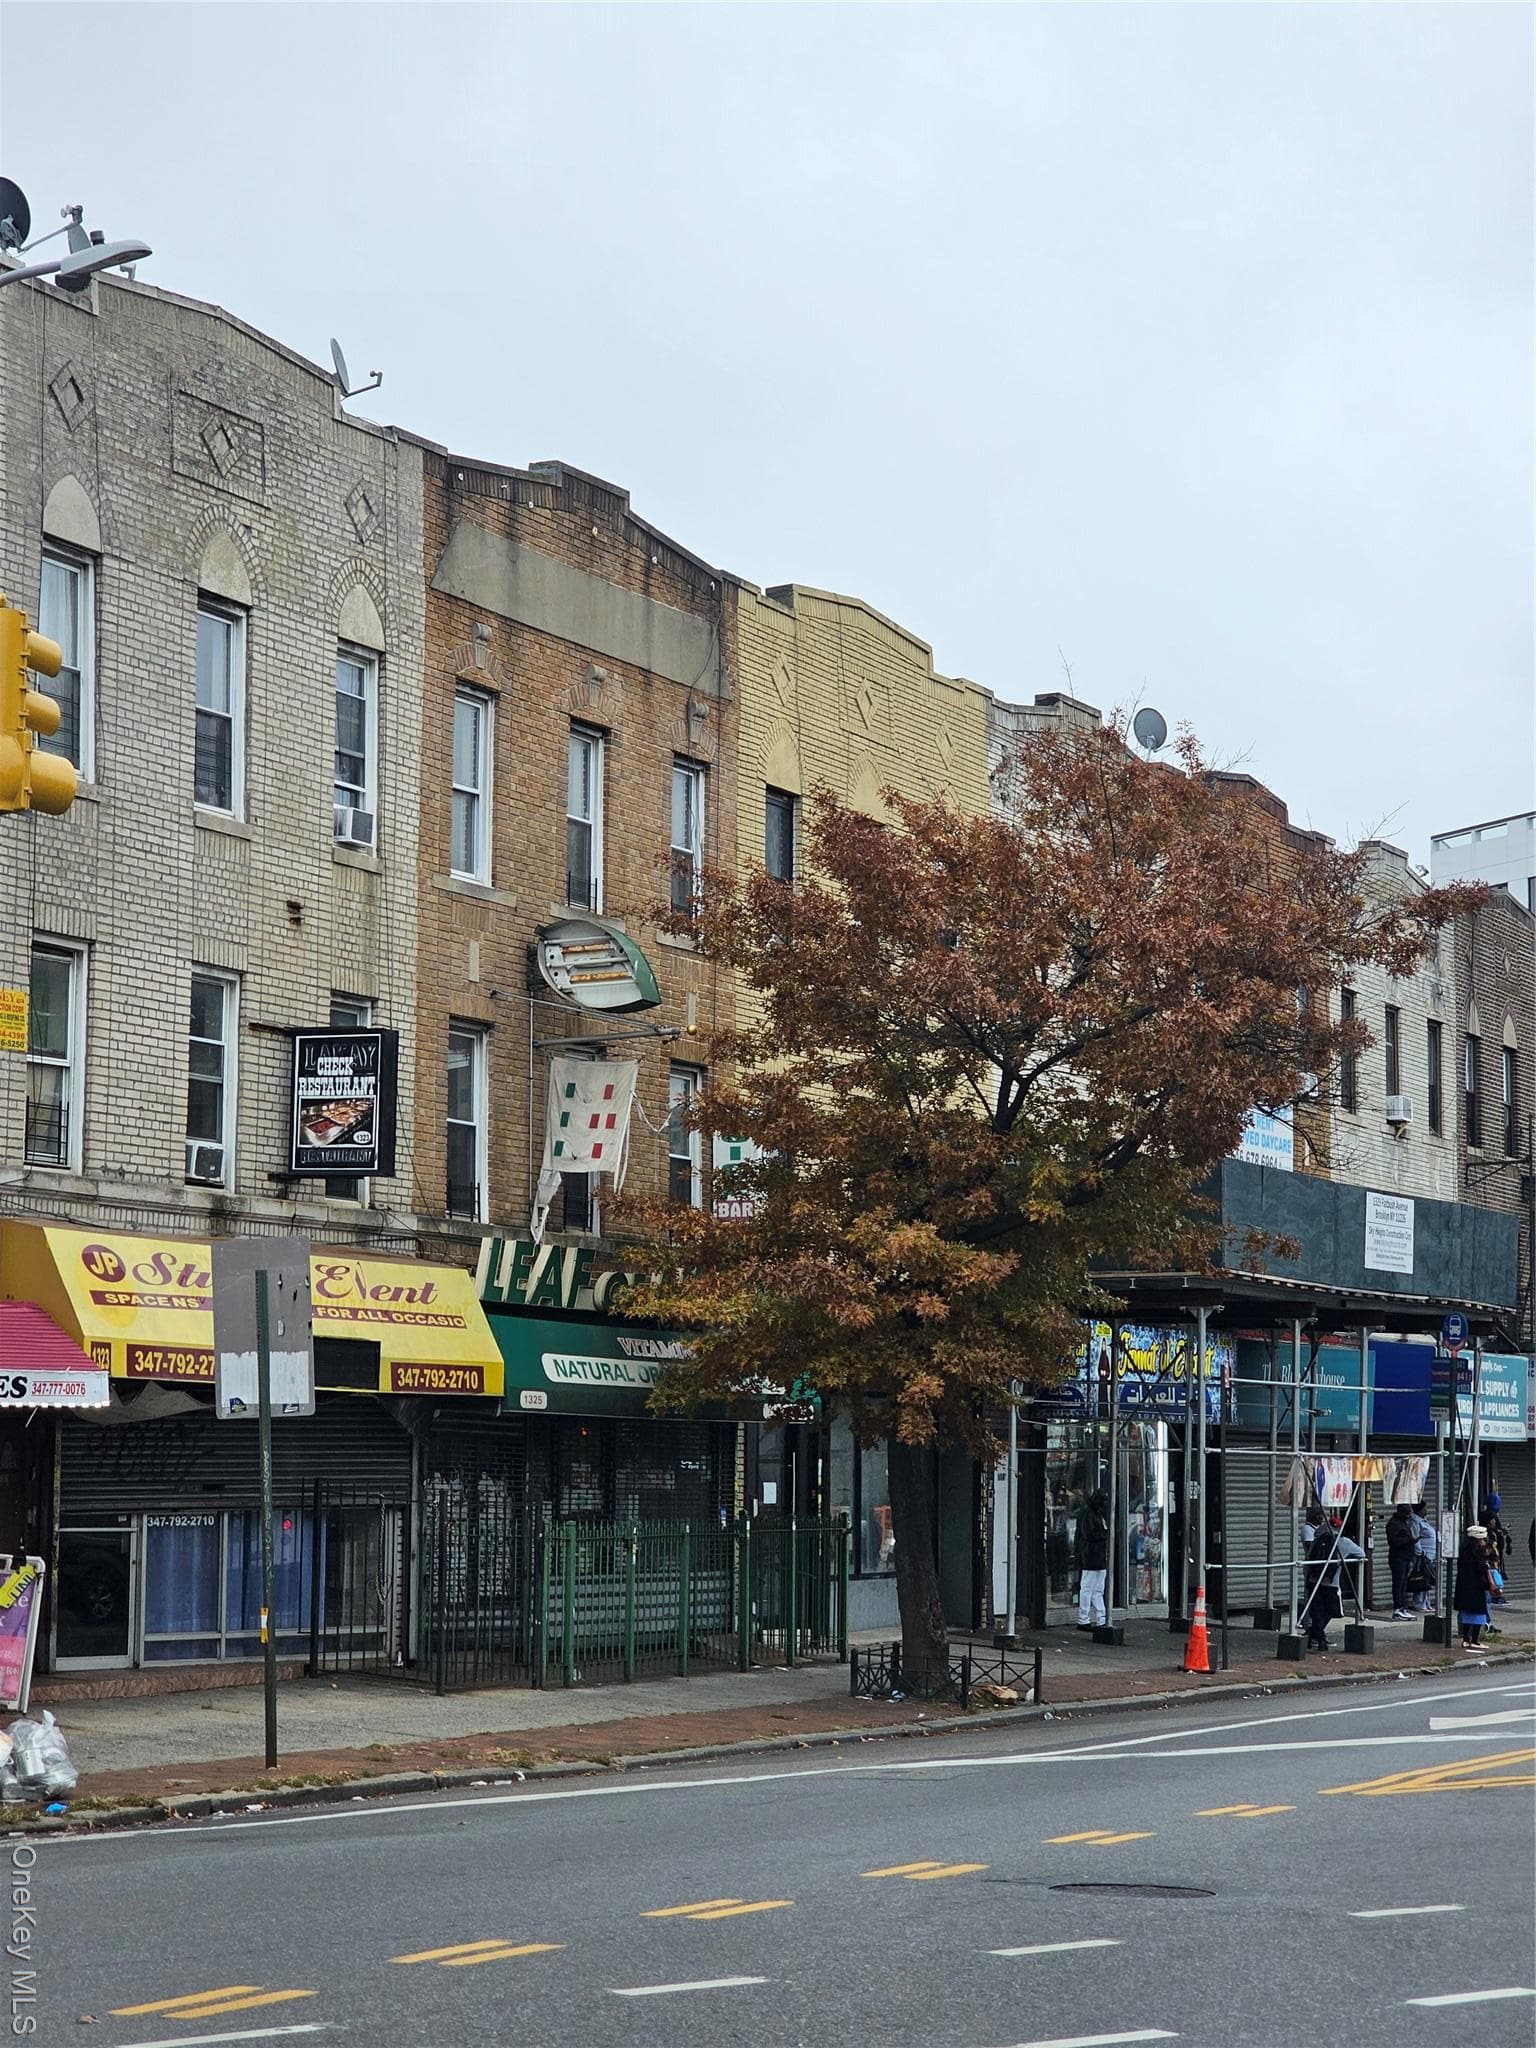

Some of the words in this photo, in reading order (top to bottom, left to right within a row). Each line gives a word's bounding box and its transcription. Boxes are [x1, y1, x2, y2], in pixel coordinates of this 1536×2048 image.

[317, 1056, 354, 1076] CHECK
[298, 1077, 376, 1096] RESTAURANT
[1261, 1134, 1292, 1153] DAYCARE
[718, 1202, 754, 1218] BAR
[90, 1251, 119, 1276] JP
[474, 1237, 596, 1309] LEAF
[318, 1307, 353, 1319] FOR
[357, 1310, 389, 1322] ALL
[392, 1314, 465, 1328] OCCASIO
[397, 1368, 479, 1390] 347-792-2710
[553, 1359, 637, 1384] NATURAL
[31, 1383, 87, 1396] 347-777-0076
[1485, 1380, 1510, 1398] SUPPLY
[523, 1394, 543, 1405] 1325
[1484, 1401, 1520, 1418] APPLIANCES
[147, 1515, 215, 1527] 347-792-2710
